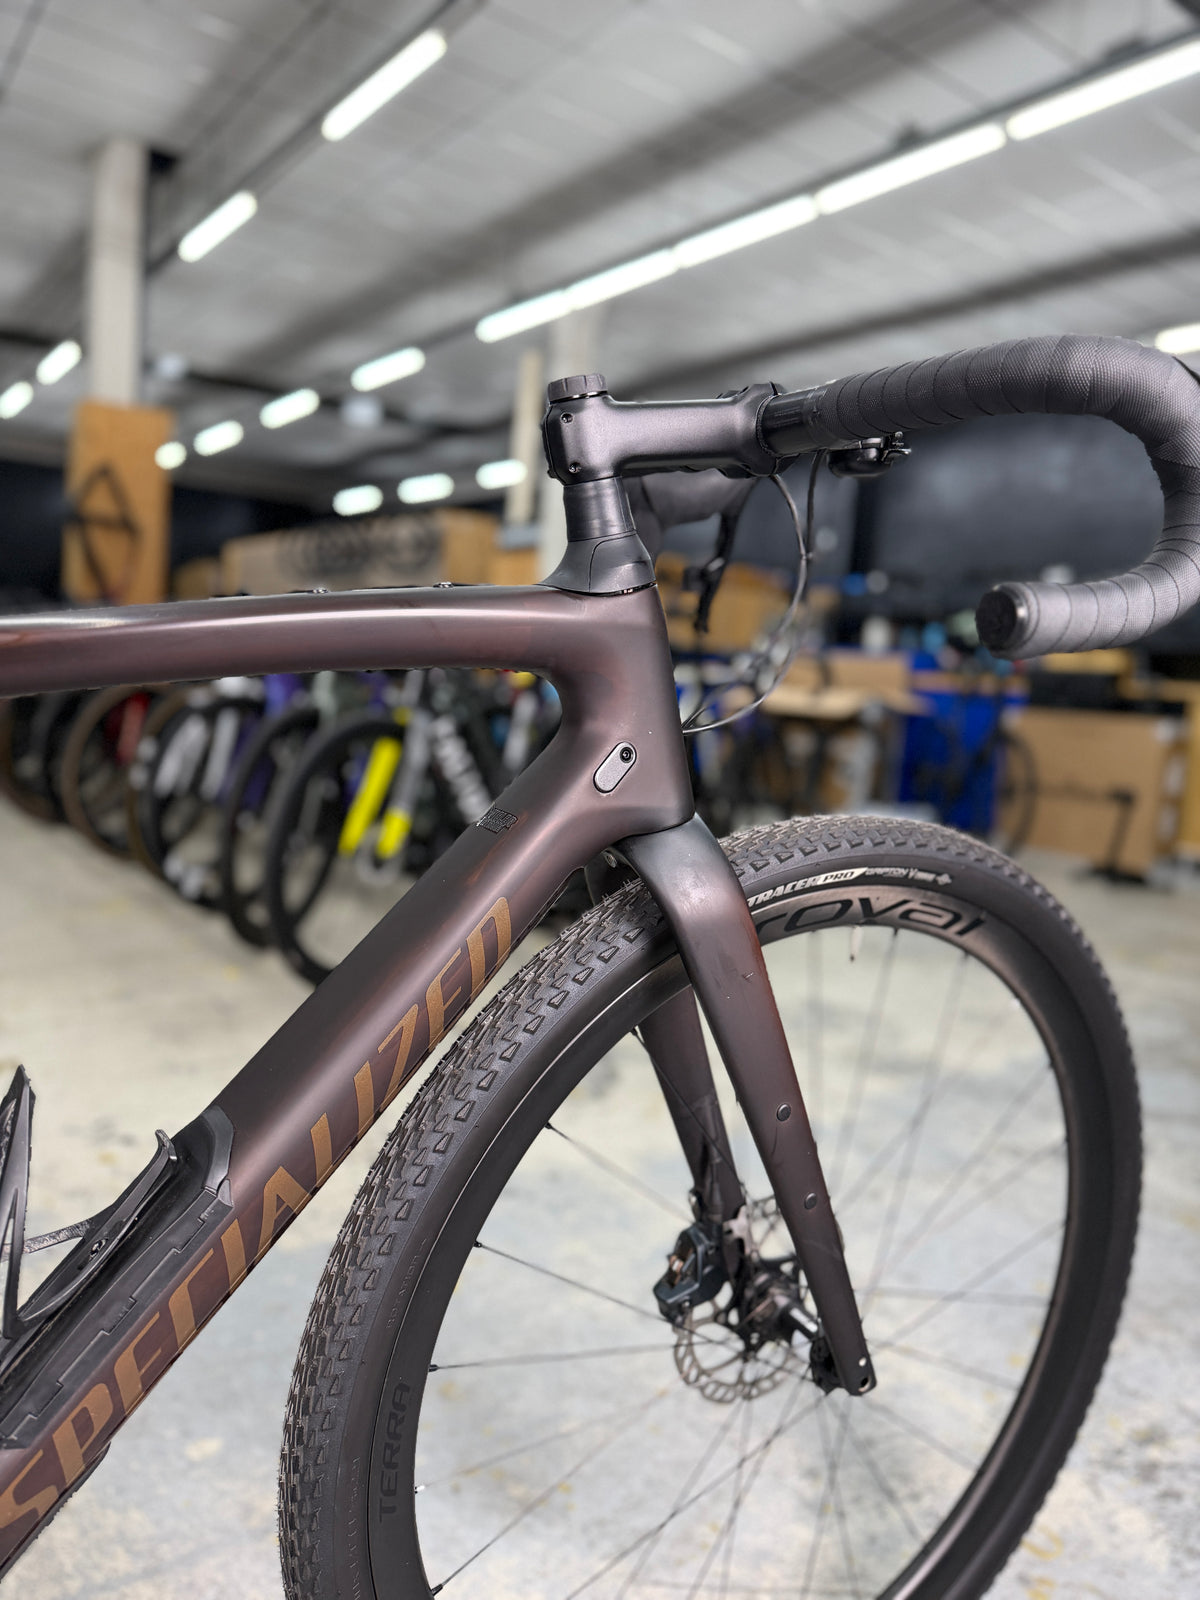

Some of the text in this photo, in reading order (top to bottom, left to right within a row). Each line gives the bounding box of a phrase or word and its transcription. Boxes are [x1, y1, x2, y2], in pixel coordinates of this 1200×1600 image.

[746, 876, 823, 908] TRACER
[823, 871, 856, 883] PRO
[379, 1382, 410, 1523] TERRA
